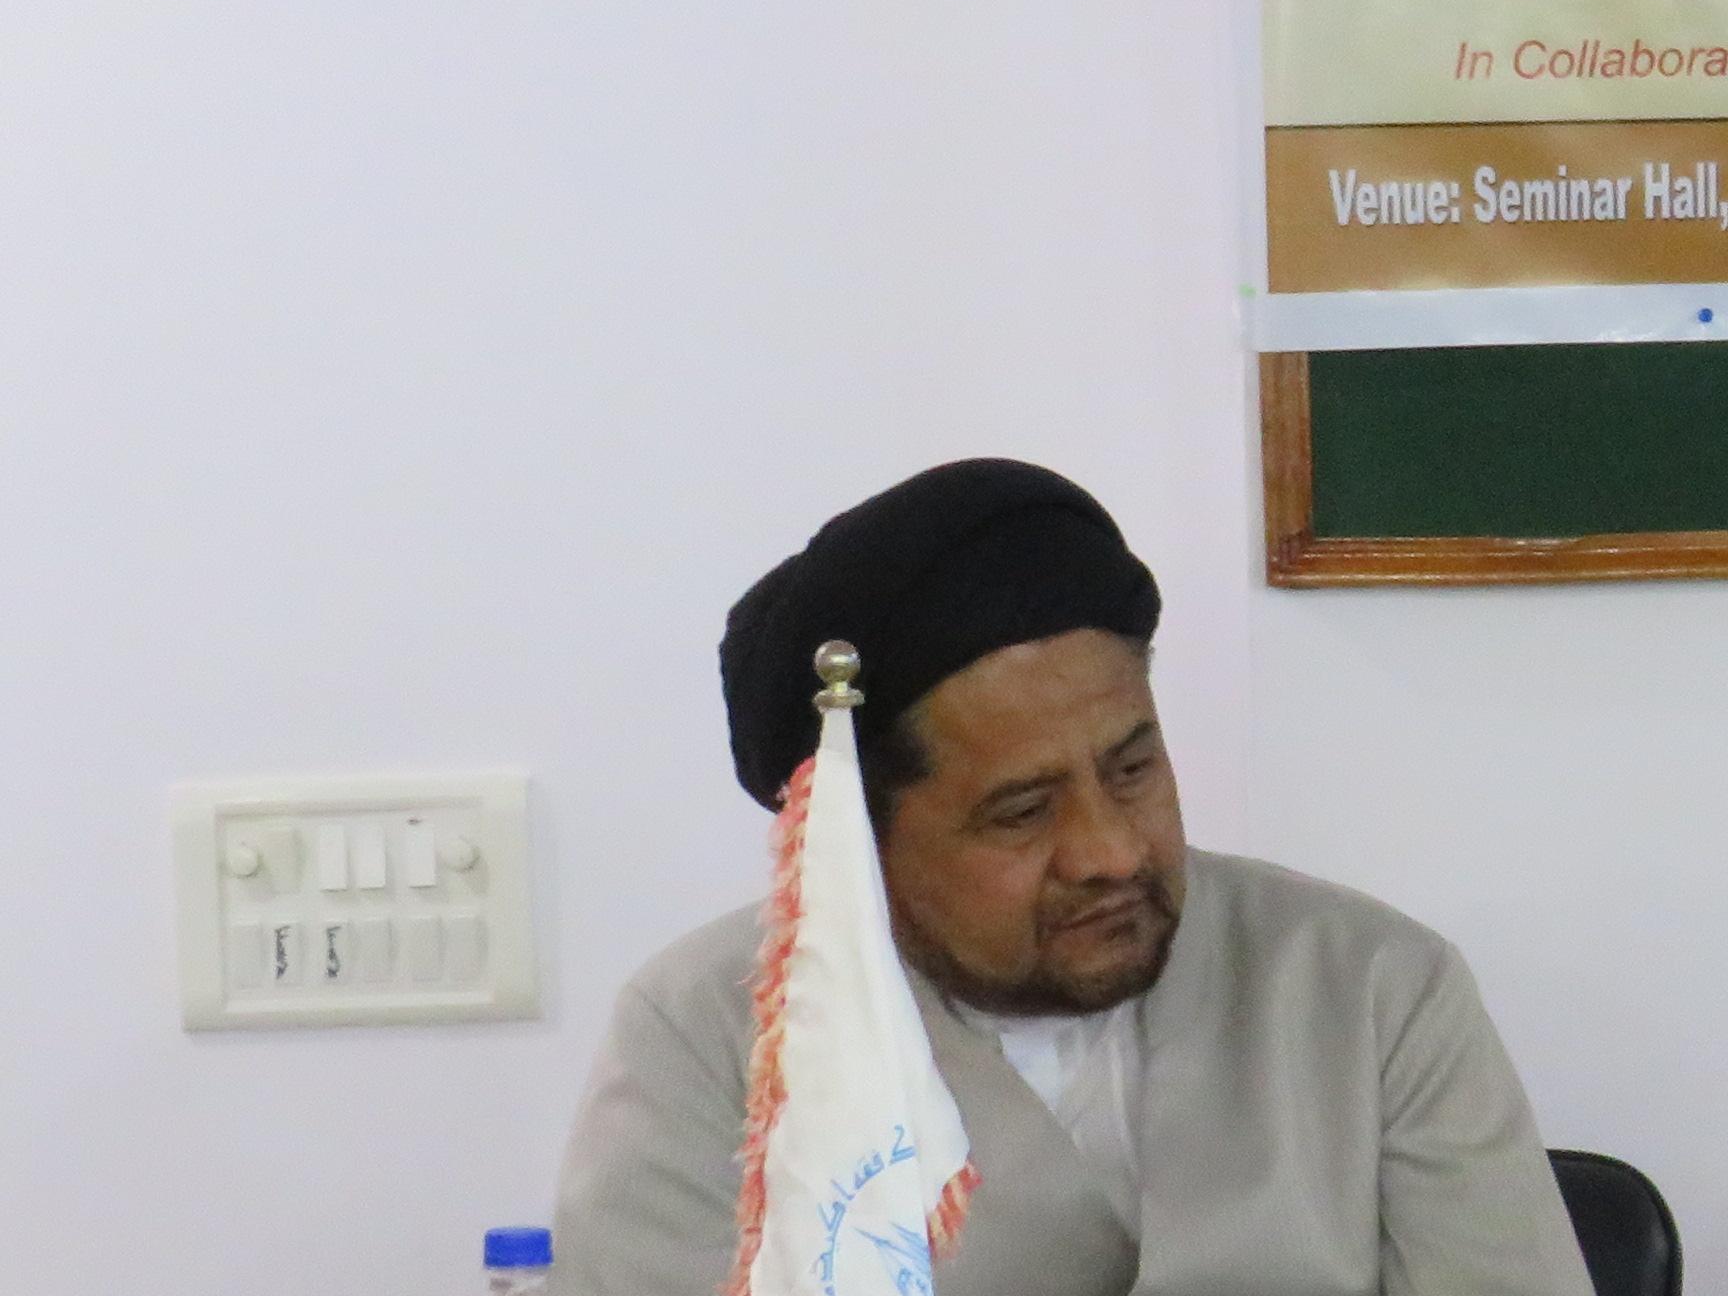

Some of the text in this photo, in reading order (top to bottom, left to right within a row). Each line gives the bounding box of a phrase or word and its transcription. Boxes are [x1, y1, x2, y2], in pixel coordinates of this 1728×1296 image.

[1455, 40, 1495, 80] In
[1328, 168, 1461, 226] Venue:
[1473, 165, 1633, 225] Seminar
